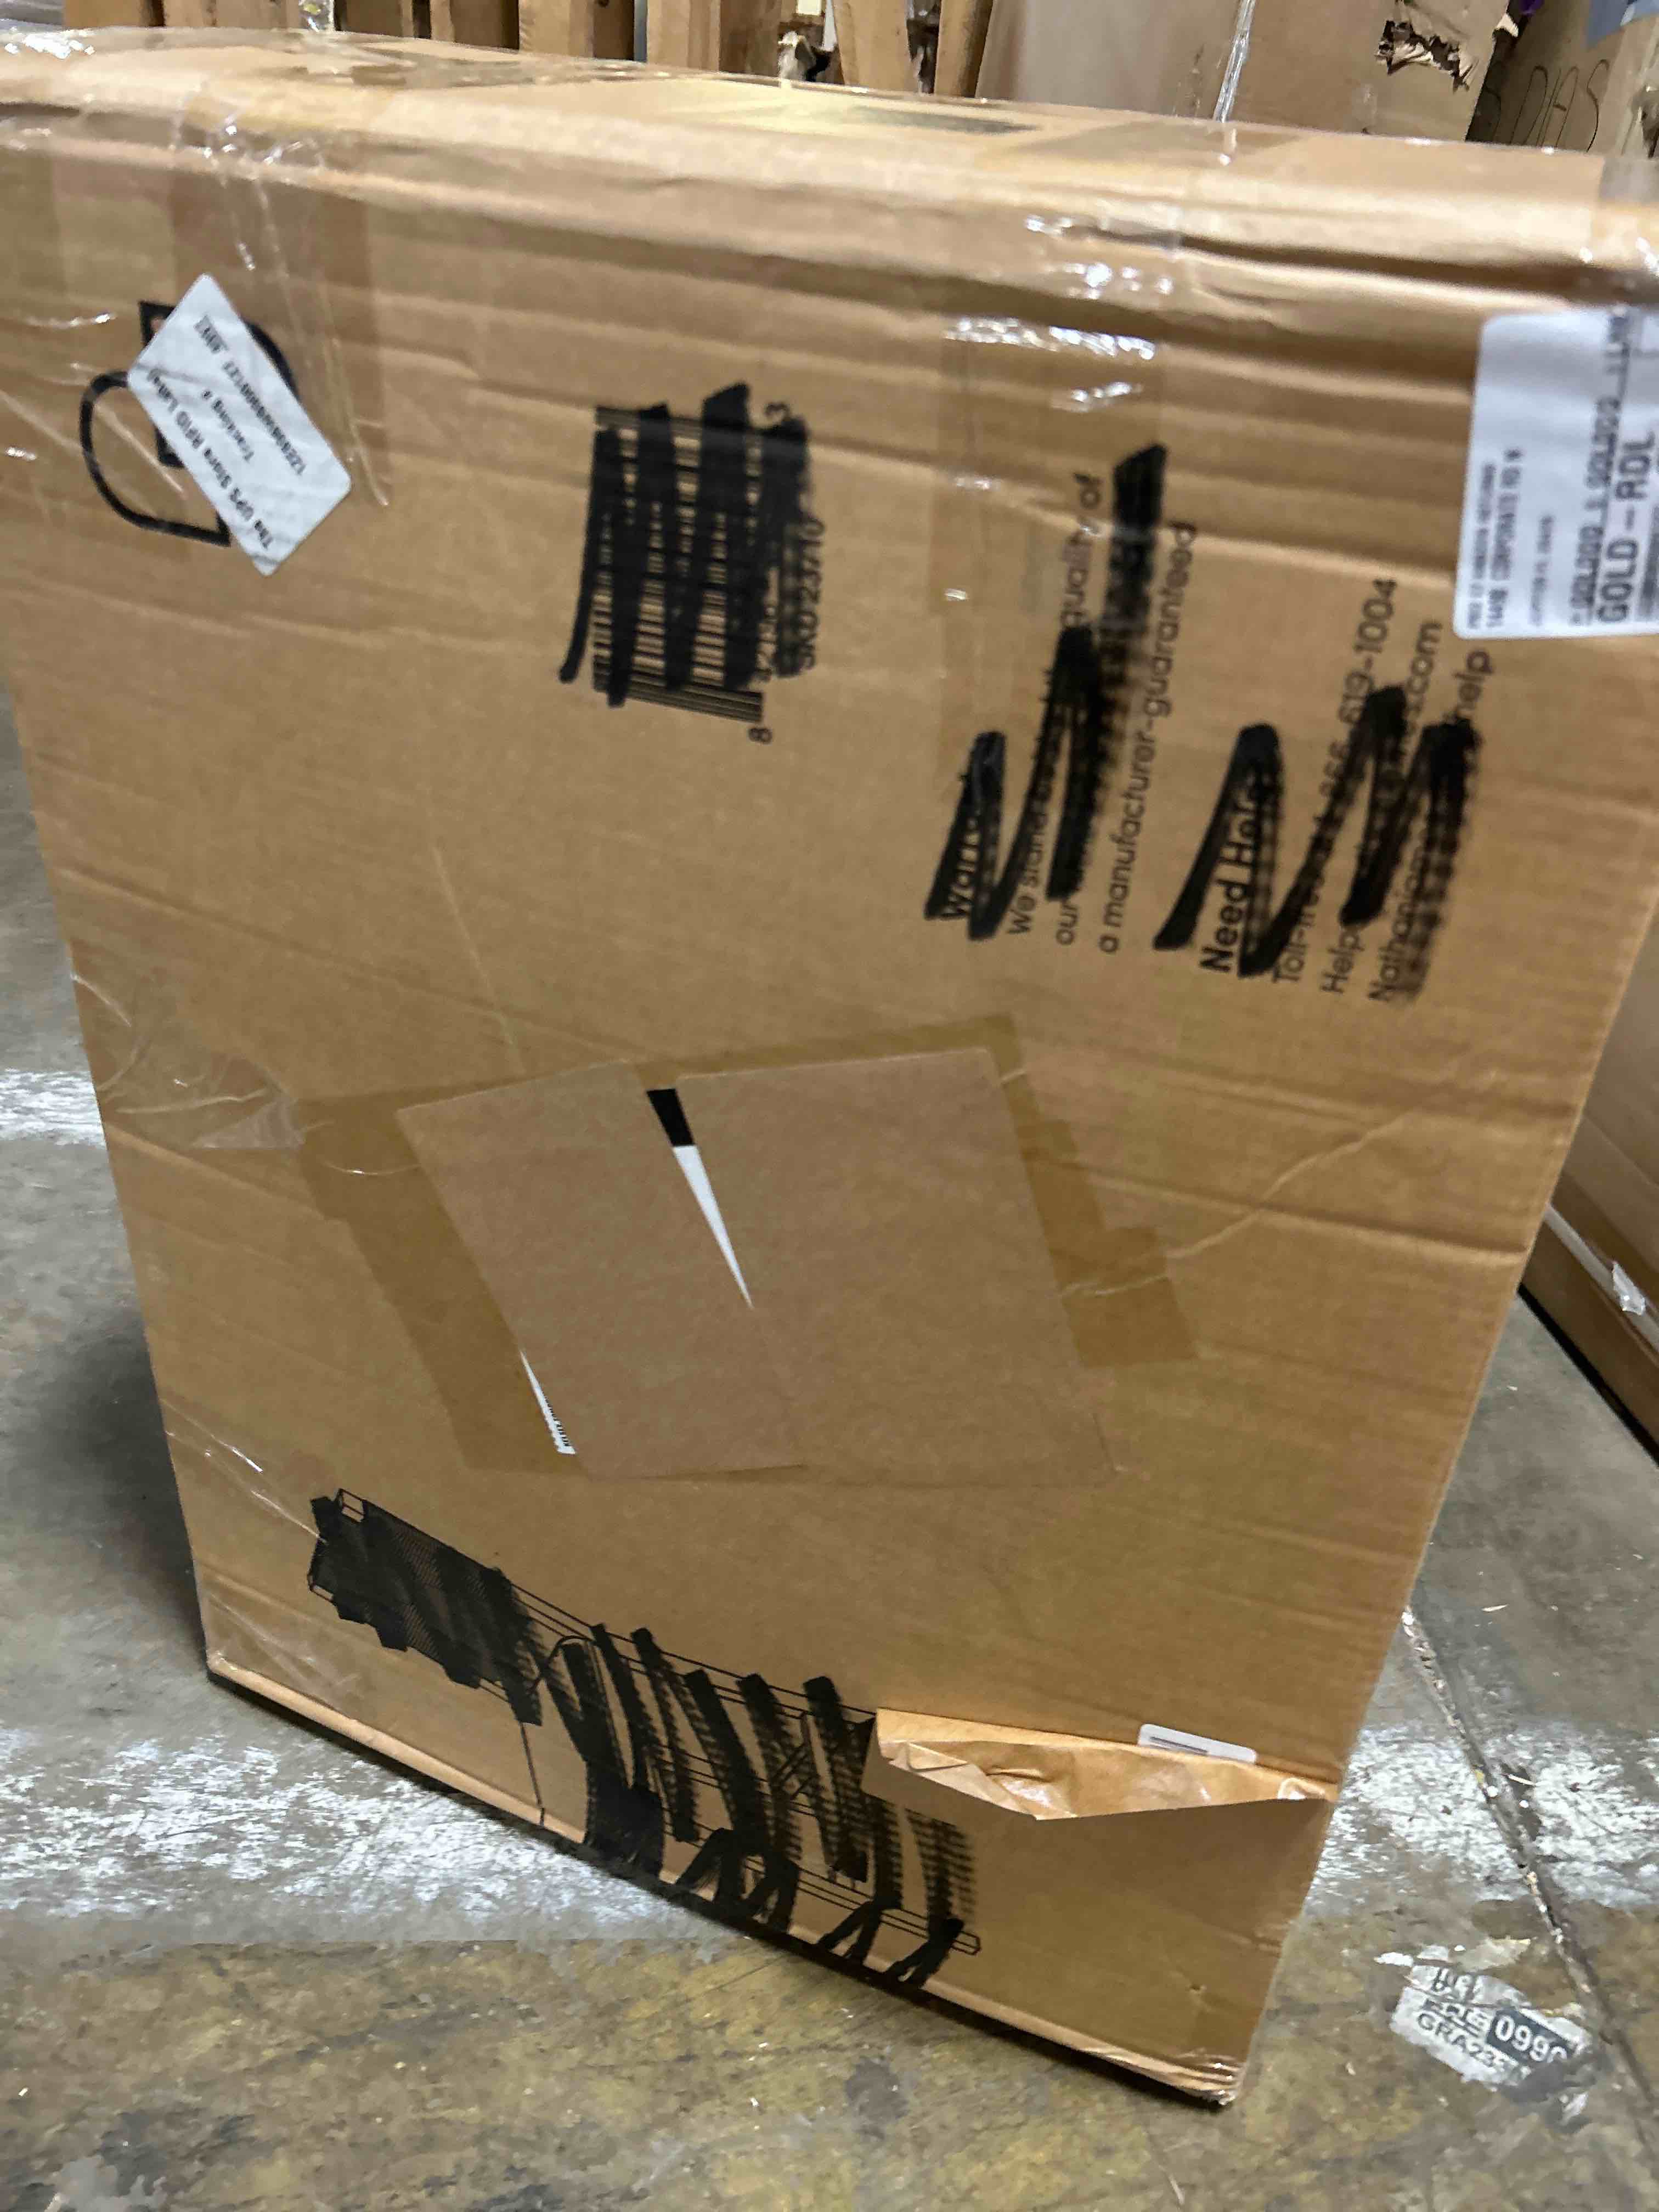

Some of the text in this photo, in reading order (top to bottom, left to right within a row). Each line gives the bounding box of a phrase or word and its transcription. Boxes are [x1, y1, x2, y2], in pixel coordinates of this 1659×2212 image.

[1596, 539, 1638, 623] GOLD
[748, 727, 772, 744] 8
[1008, 893, 1036, 936] We
[1074, 471, 1104, 507] of
[1104, 520, 1198, 923] manufacturer-guaranteed
[1099, 934, 1119, 954] a
[1200, 876, 1252, 973] Need
